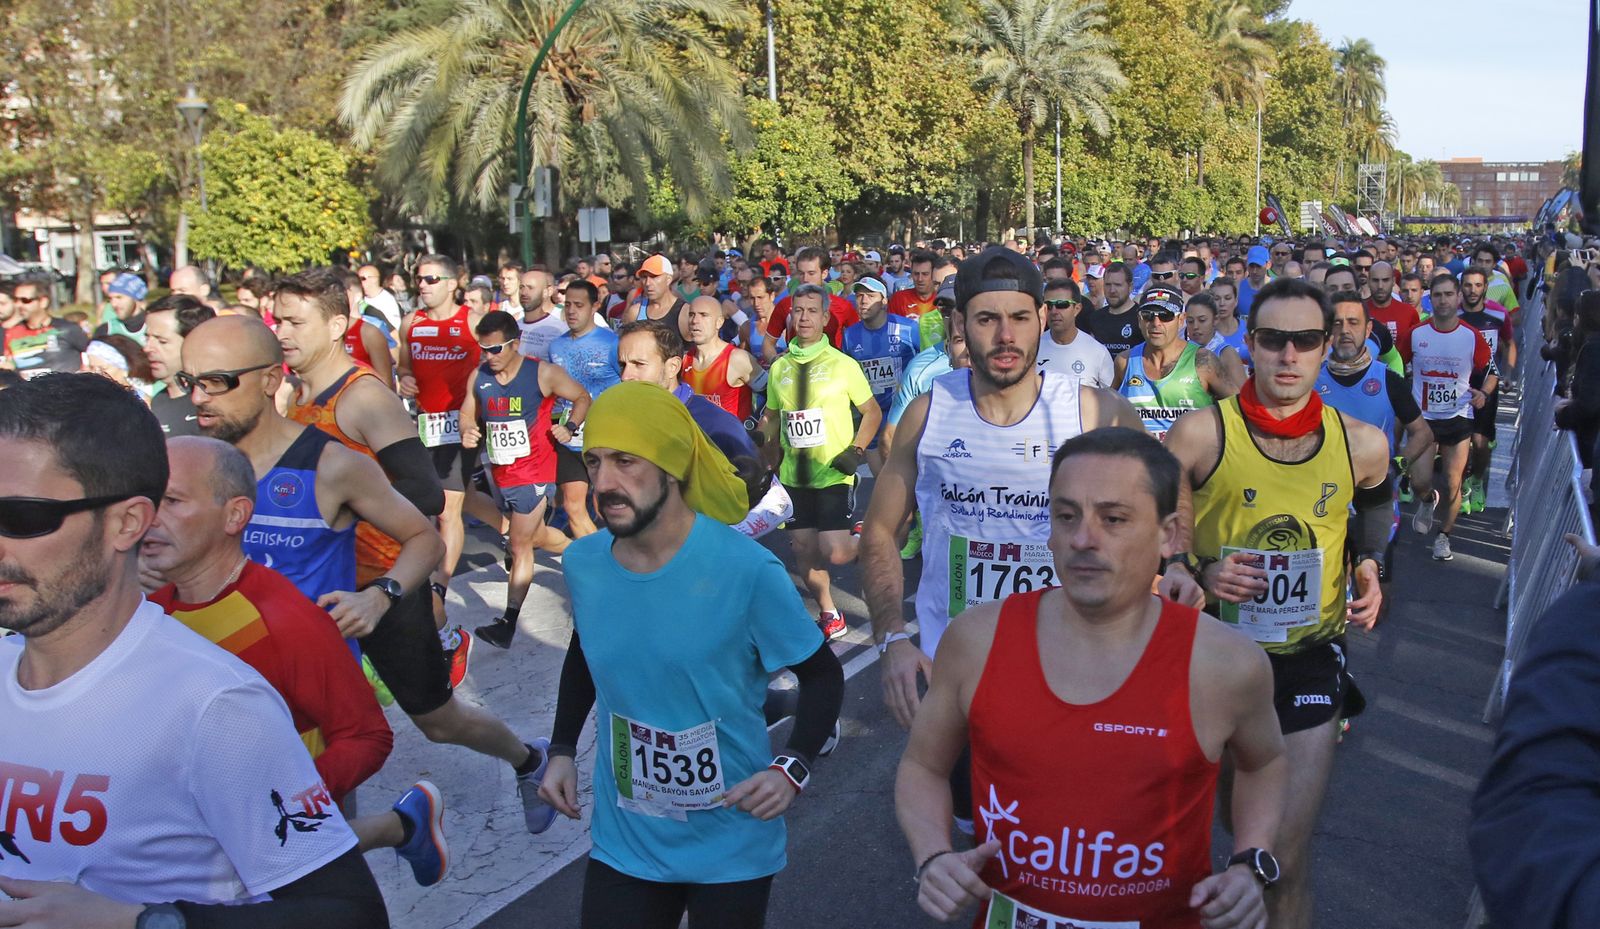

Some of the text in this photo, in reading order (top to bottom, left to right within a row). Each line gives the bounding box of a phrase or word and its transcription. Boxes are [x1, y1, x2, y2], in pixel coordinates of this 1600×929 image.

[865, 365, 894, 381] 1744
[1428, 389, 1457, 403] 4364
[429, 419, 460, 436] 1109
[787, 419, 821, 437] 1007
[492, 430, 526, 448] 1853
[941, 484, 985, 503] Falcón
[951, 503, 976, 516] Salud
[987, 507, 1049, 521] Rendimiento
[243, 531, 304, 548] LETISMO
[970, 562, 1054, 600] 1763
[679, 733, 688, 741] 35
[1093, 722, 1156, 736] GSPORT
[635, 744, 717, 787] 1538
[632, 778, 660, 792] MANUEL
[689, 782, 721, 797] SAYAGO
[1008, 826, 1165, 878] califas
